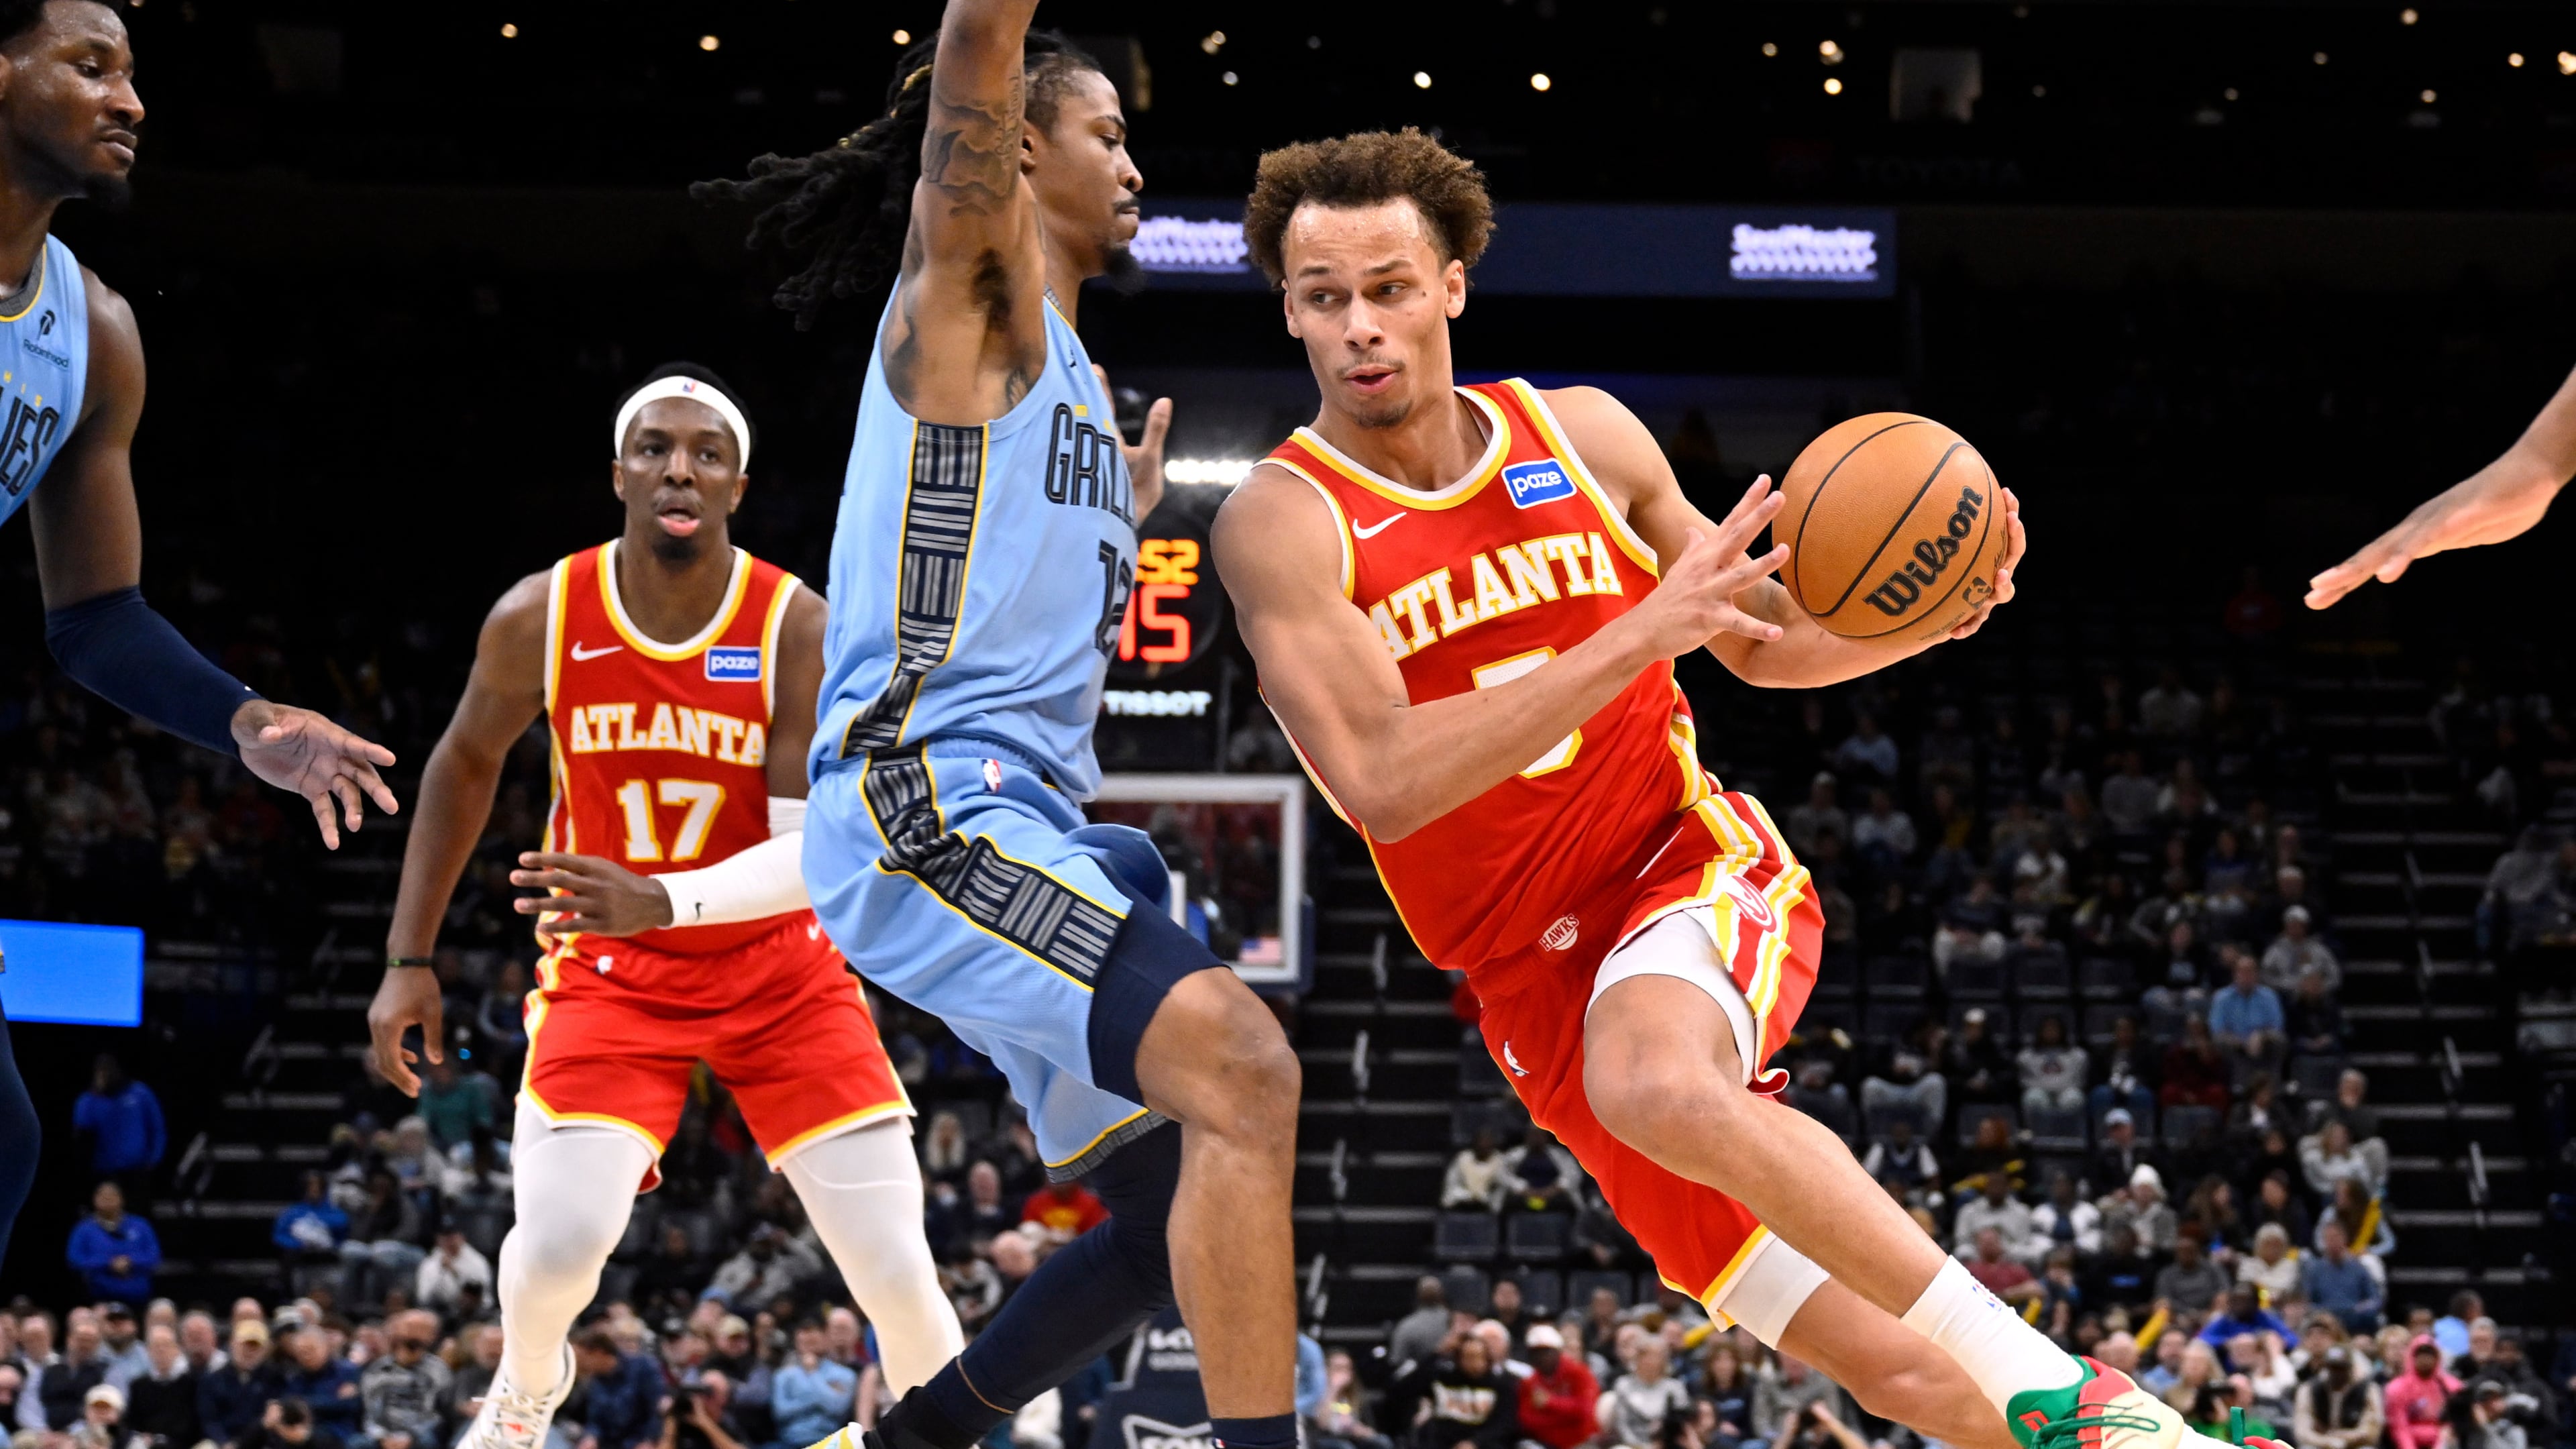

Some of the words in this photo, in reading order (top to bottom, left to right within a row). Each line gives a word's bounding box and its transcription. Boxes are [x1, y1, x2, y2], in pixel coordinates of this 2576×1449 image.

[1511, 471, 1562, 498] paze
[1862, 485, 1984, 617] Wilson
[1369, 531, 1624, 661] ATLANTA
[711, 655, 758, 673] paze
[1102, 690, 1212, 716] TISSOT
[572, 702, 767, 768] ATLANTA
[616, 778, 727, 863] 17
[1538, 913, 1580, 952] HAWKS
